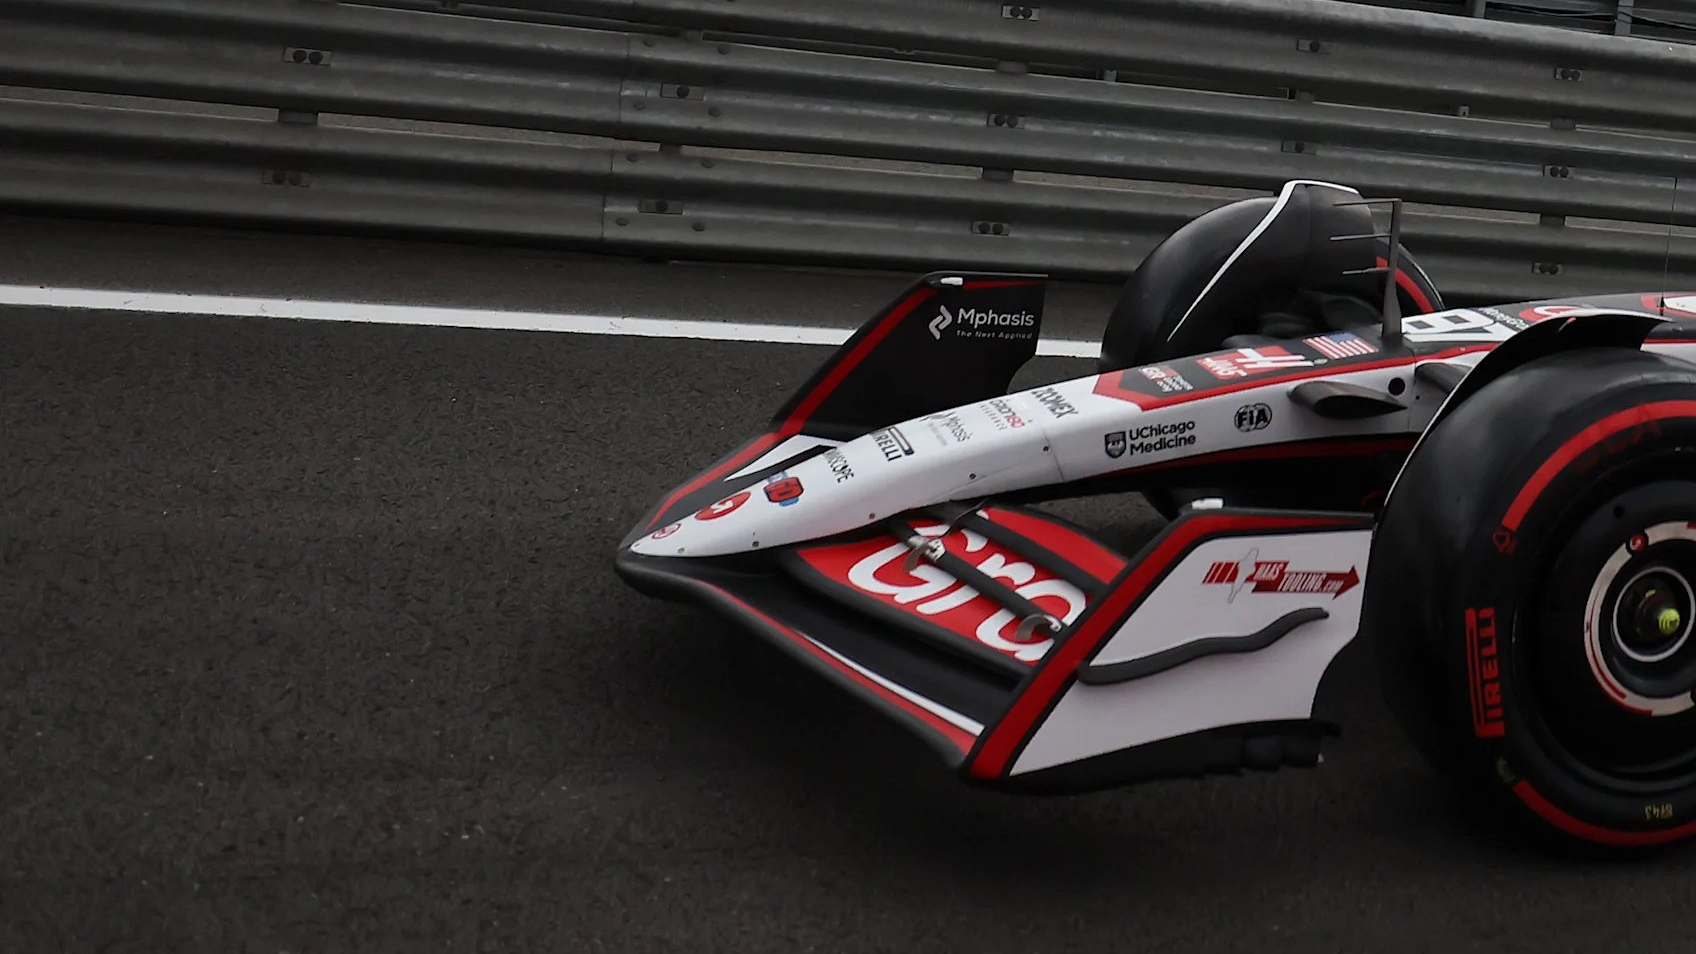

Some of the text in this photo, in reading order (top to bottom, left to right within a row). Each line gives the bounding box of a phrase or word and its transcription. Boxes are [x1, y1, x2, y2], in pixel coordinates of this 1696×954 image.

[957, 308, 1035, 329] Mphasis
[1236, 408, 1268, 428] FIA
[1129, 421, 1195, 441] UChicago
[1130, 433, 1196, 456] Medicine
[1254, 563, 1284, 581] HAAS
[1465, 607, 1506, 738] PIRELLI
